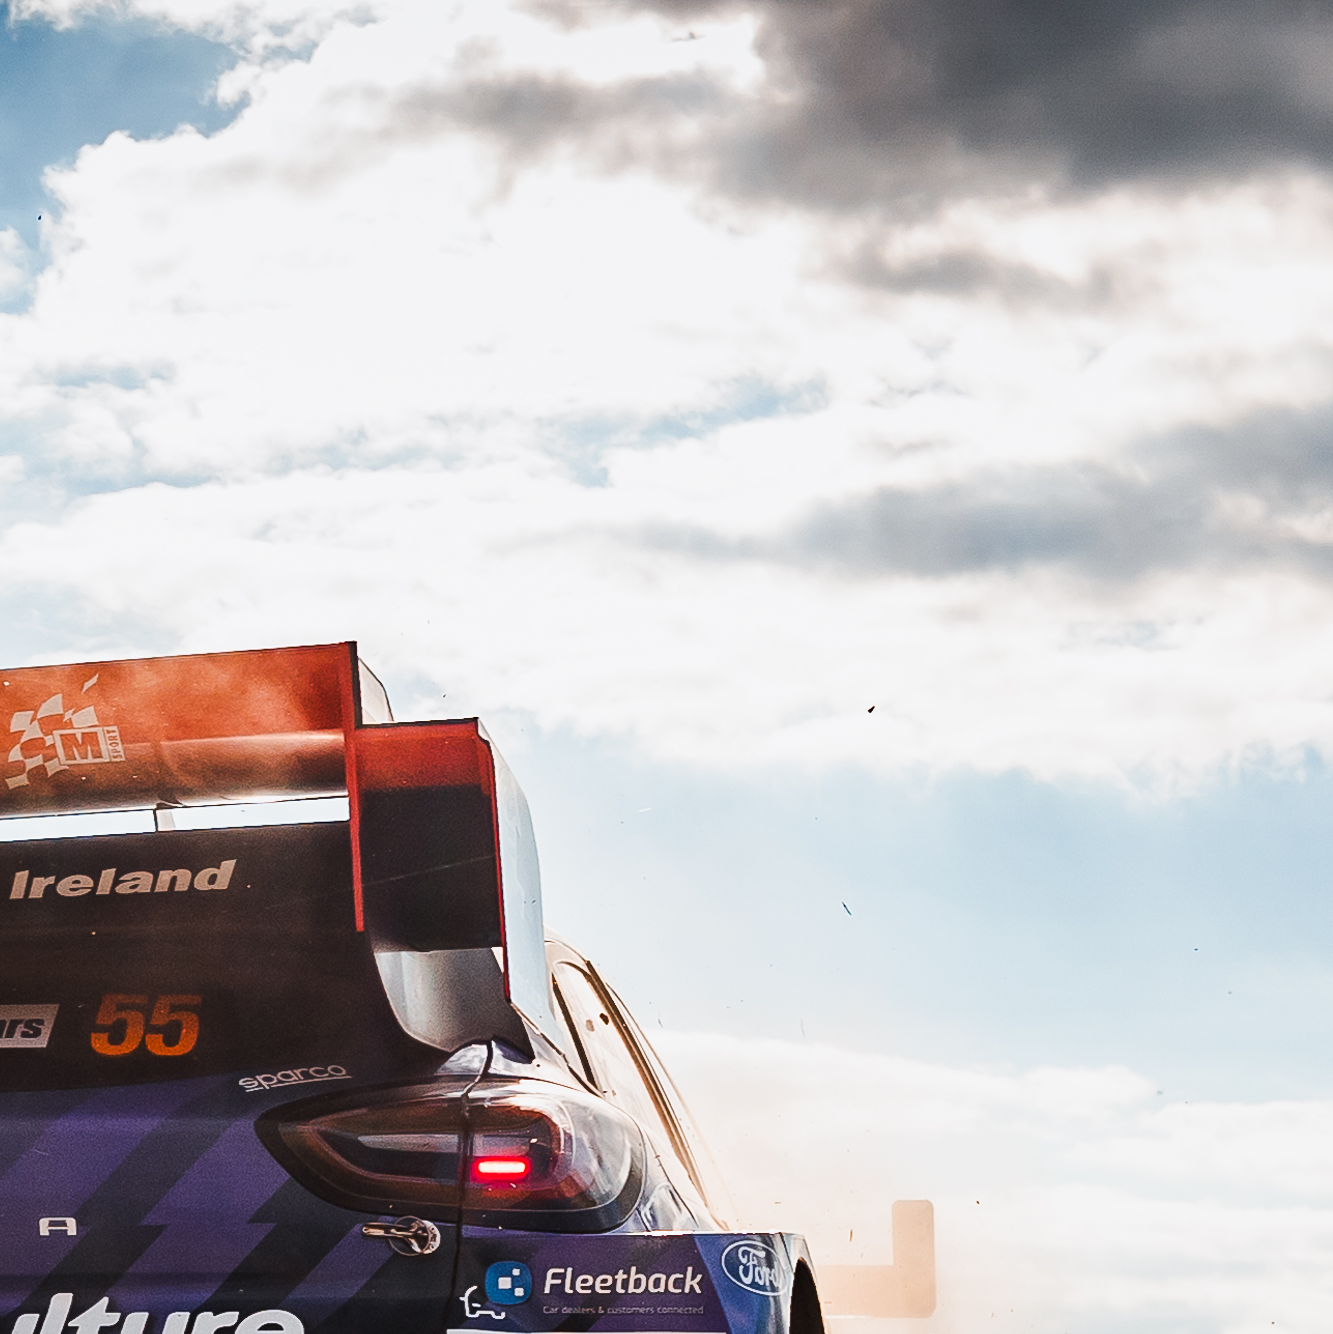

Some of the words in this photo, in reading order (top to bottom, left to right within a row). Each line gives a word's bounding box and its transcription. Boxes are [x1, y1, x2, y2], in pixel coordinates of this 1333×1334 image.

[59, 730, 104, 762] M
[106, 729, 123, 760] SPORT
[9, 859, 237, 899] Ireland
[91, 994, 202, 1056] 55
[239, 1065, 348, 1090] sparco
[543, 1266, 703, 1294] Fleetback
[738, 1246, 781, 1291] Ford
[542, 1305, 559, 1314] Car
[561, 1305, 596, 1314] dealers
[597, 1305, 604, 1314] &
[607, 1305, 655, 1314] customers
[656, 1305, 704, 1314] connected
